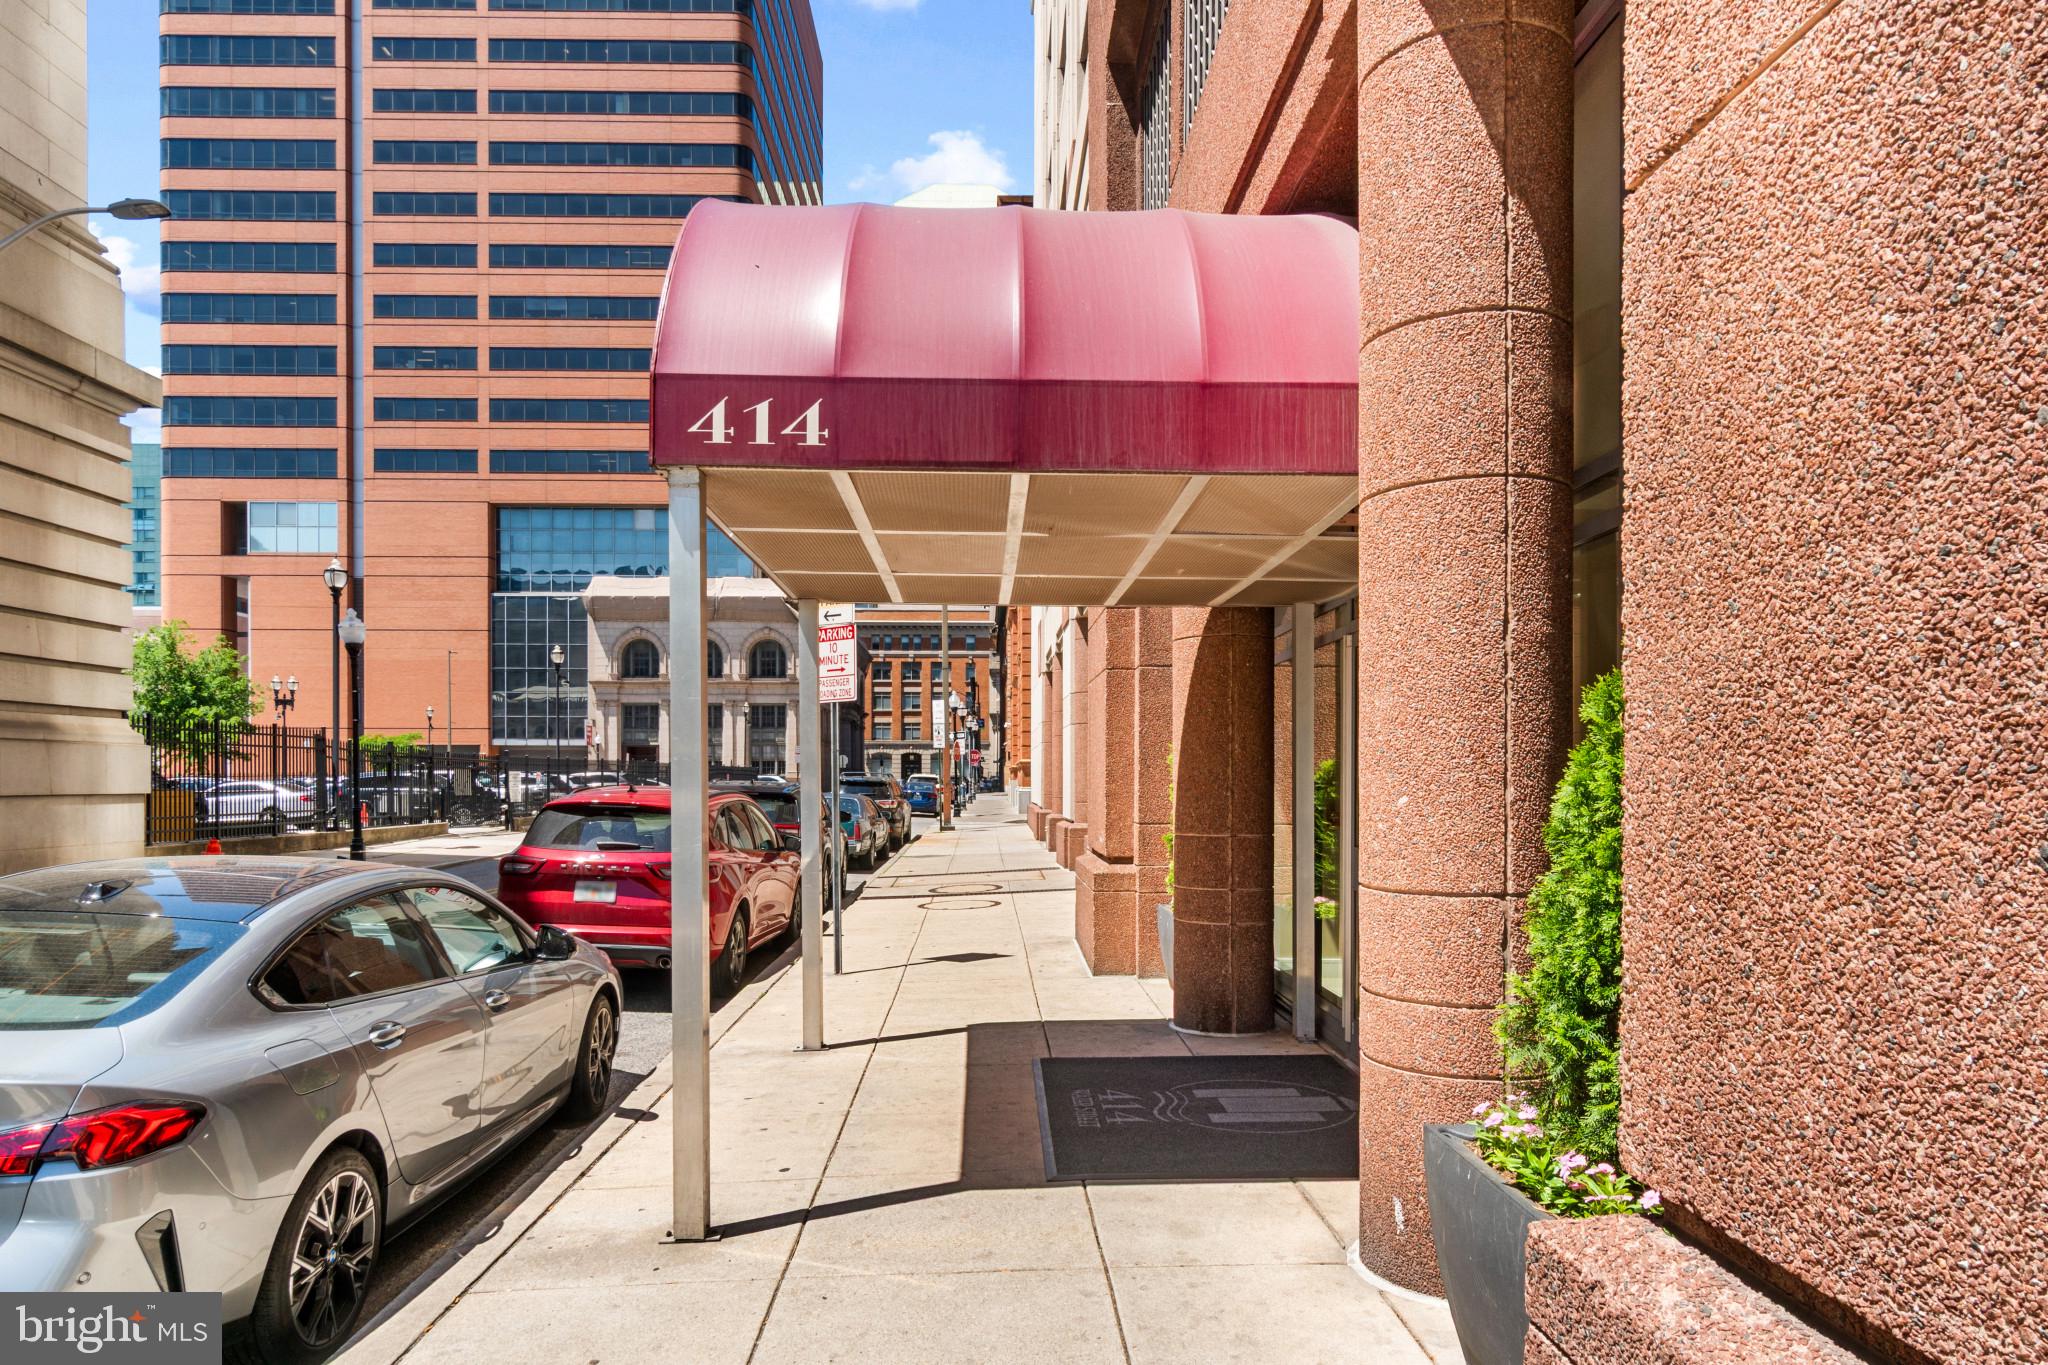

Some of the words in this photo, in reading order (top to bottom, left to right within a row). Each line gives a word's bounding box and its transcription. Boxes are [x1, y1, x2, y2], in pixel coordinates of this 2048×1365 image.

[687, 396, 829, 446] 414
[829, 642, 838, 653] 10
[819, 653, 849, 665] MINUTE
[819, 689, 838, 698] OADING
[1098, 1088, 1153, 1124] 414
